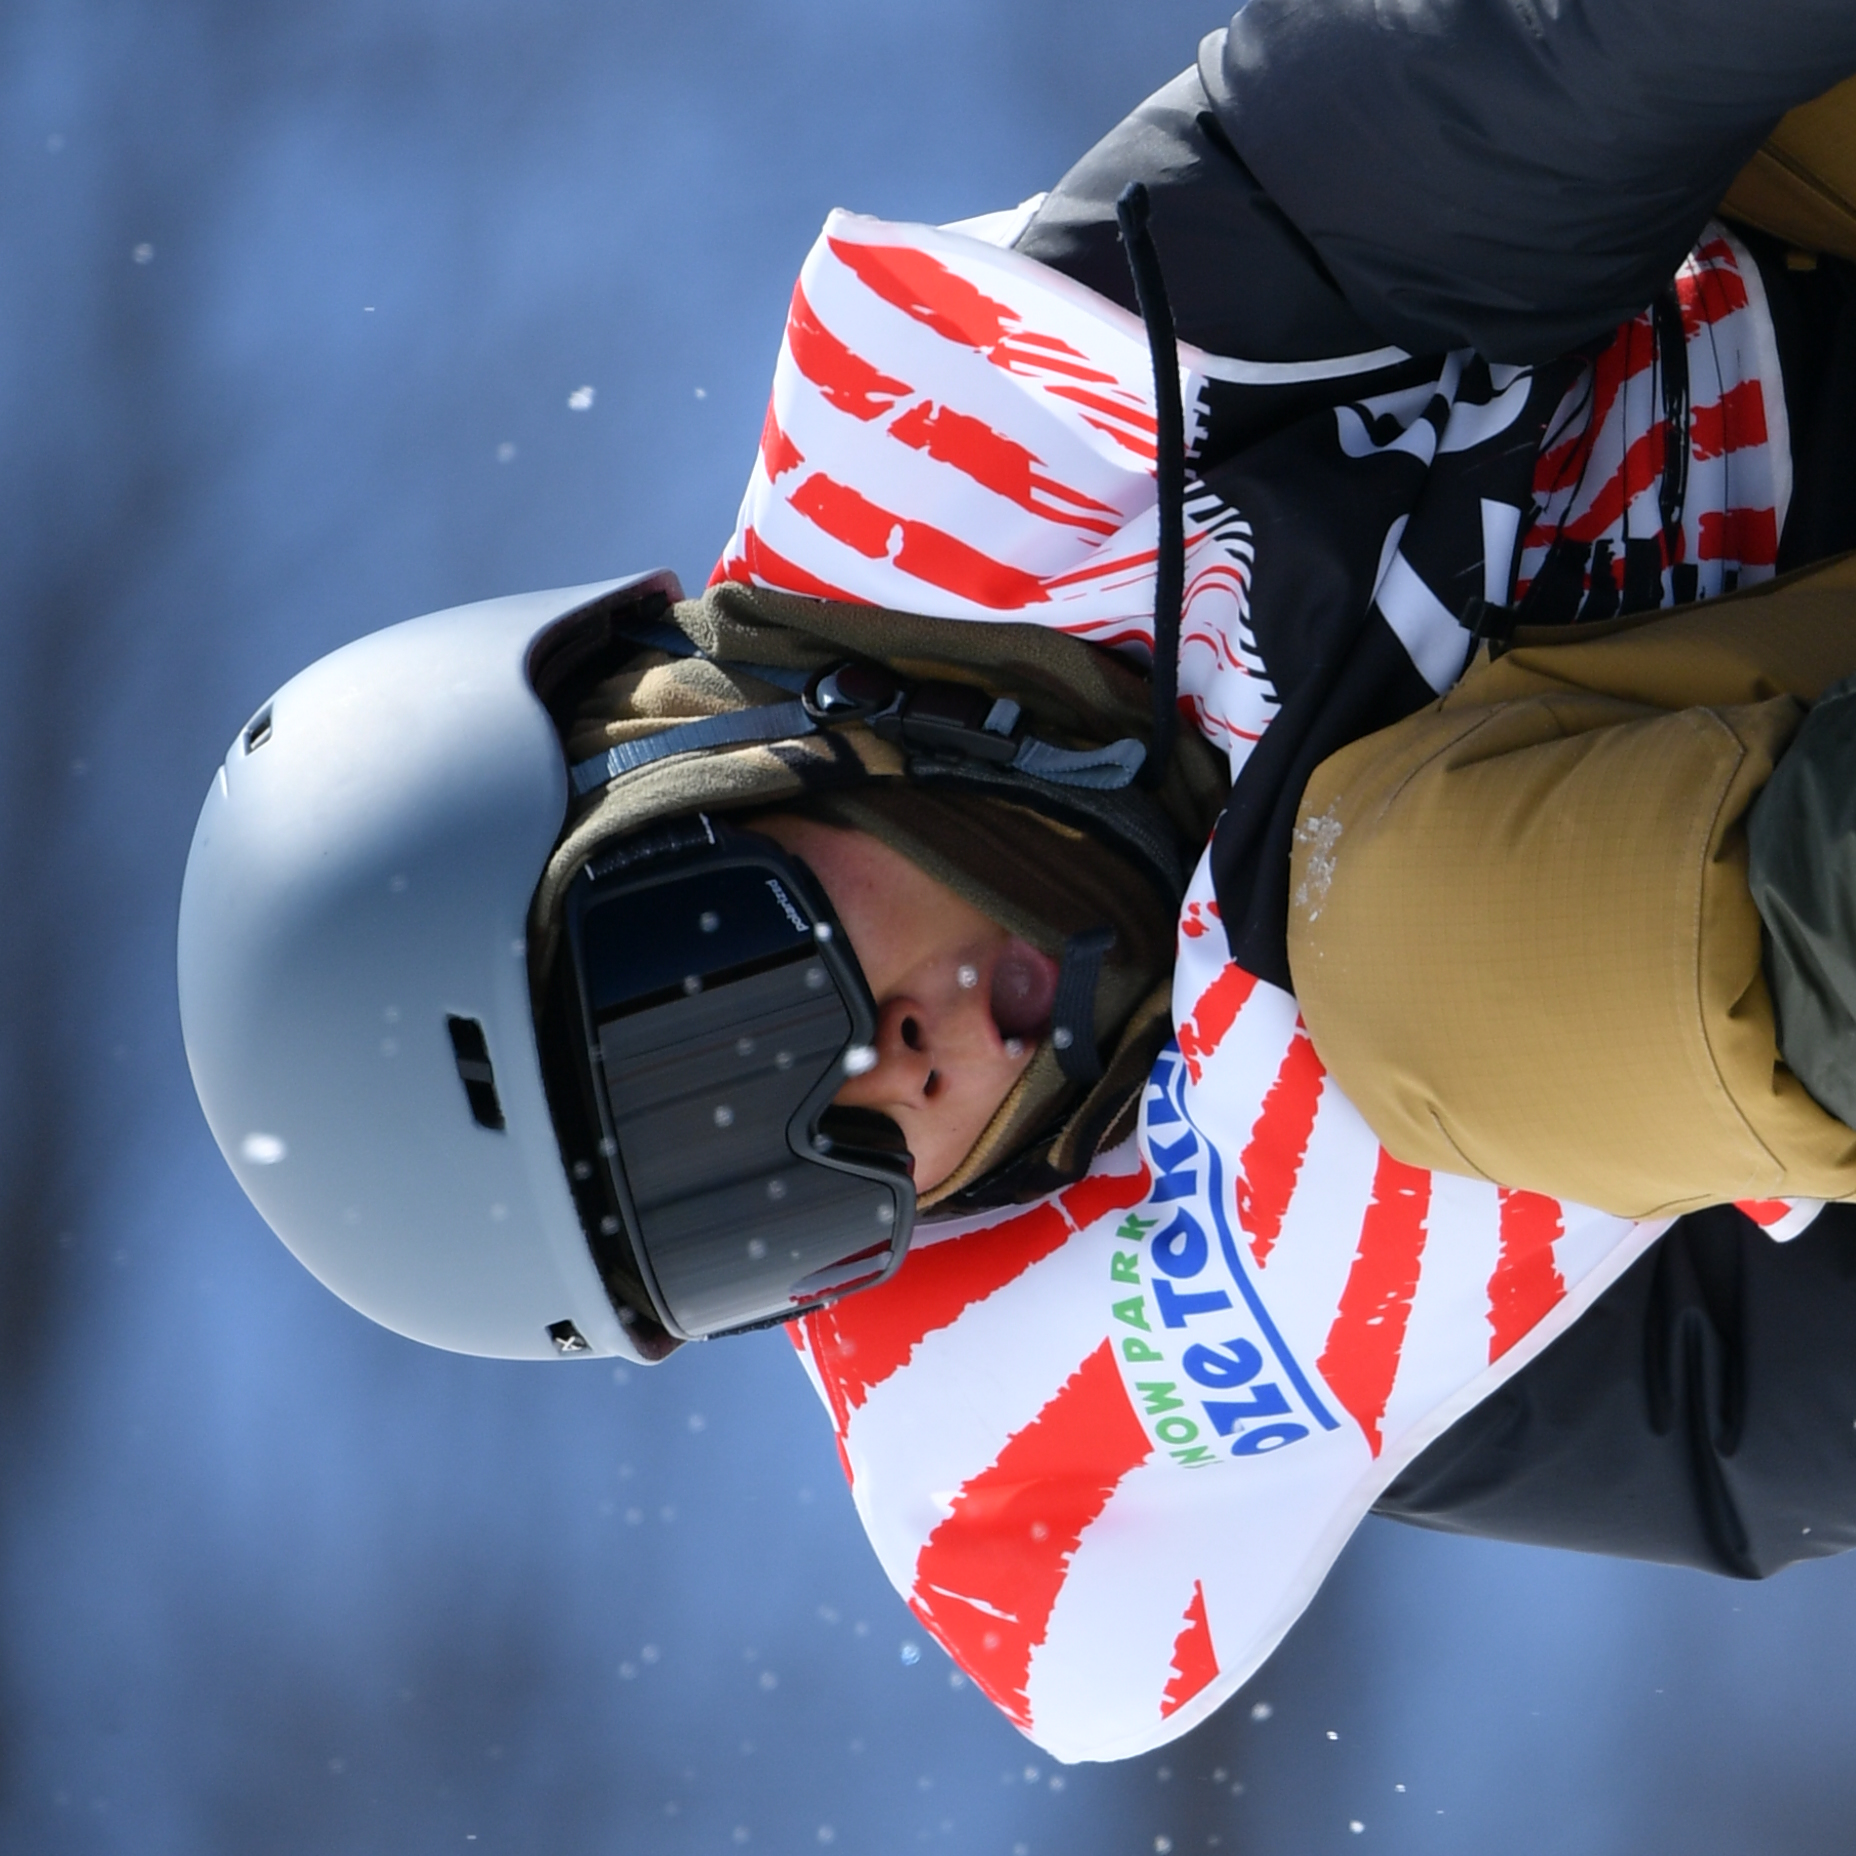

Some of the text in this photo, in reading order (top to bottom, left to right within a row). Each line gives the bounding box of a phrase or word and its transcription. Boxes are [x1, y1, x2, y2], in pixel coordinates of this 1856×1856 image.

[766, 879, 809, 932] polarized
[1111, 1212, 1224, 1469] NOW PARK
